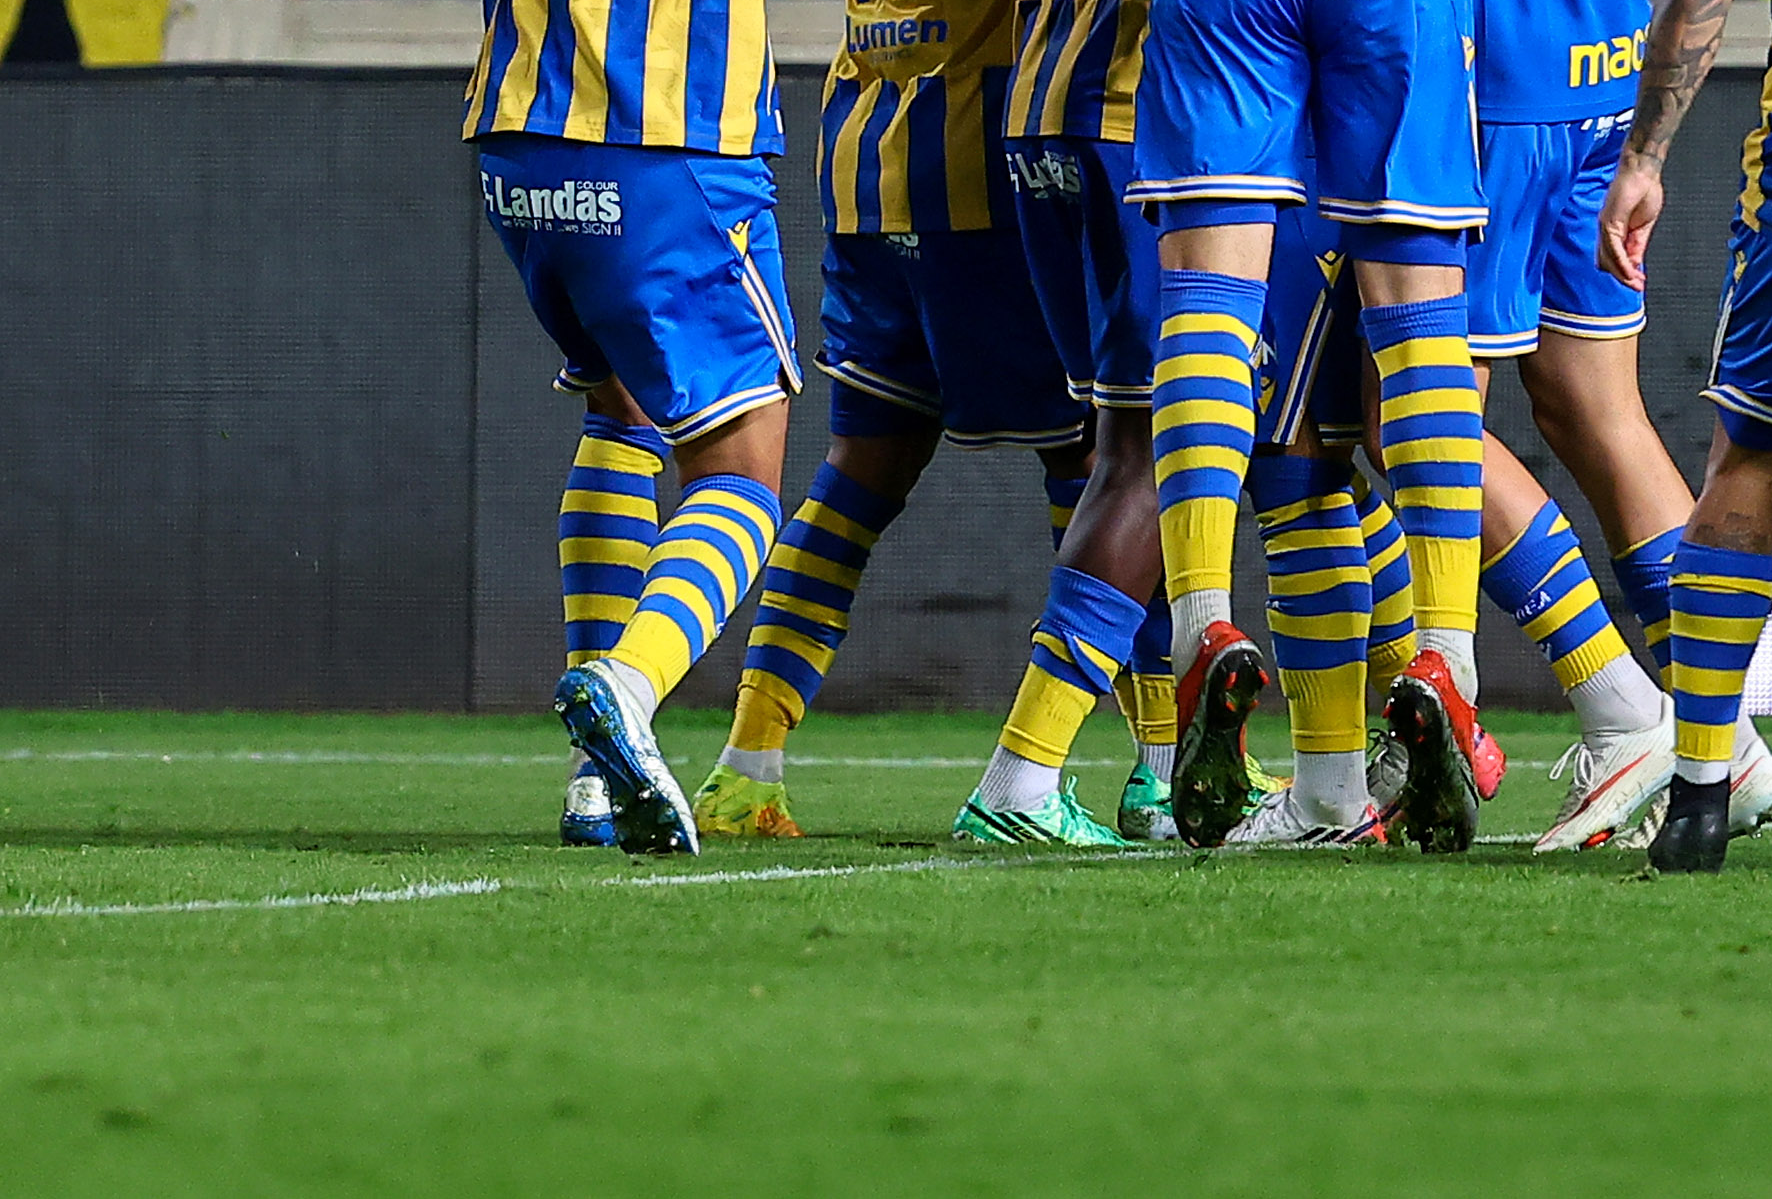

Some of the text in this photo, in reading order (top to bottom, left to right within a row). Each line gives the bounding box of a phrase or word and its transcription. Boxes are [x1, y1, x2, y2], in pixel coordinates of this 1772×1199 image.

[576, 181, 618, 191] COLOUR
[494, 176, 622, 224] Landas
[582, 222, 611, 236] SIGN
